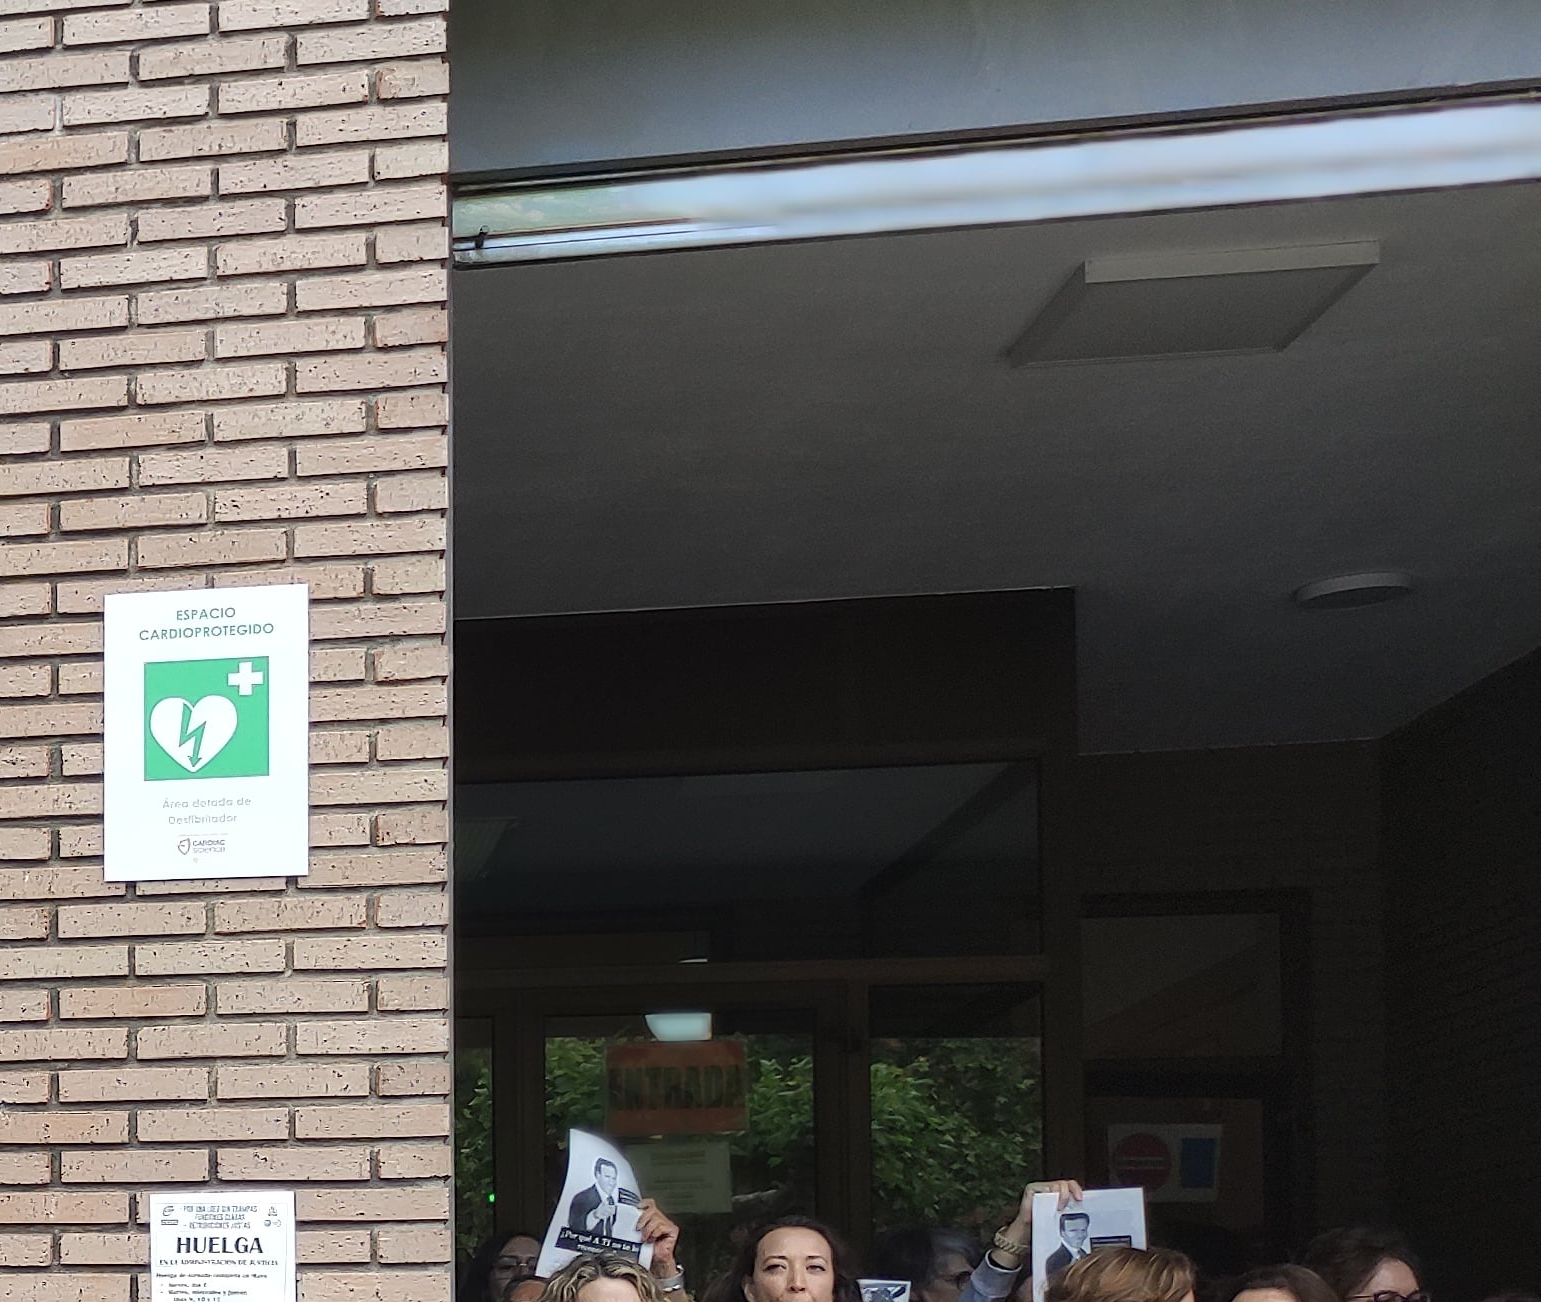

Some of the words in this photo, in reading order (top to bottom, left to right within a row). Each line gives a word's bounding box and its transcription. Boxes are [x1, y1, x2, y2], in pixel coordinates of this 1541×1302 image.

[176, 607, 236, 621] ESPACIO
[139, 623, 274, 641] CARDIOPROTEGIDO
[192, 798, 233, 808] dotada
[236, 797, 252, 806] de
[176, 1236, 263, 1254] HUELGA
